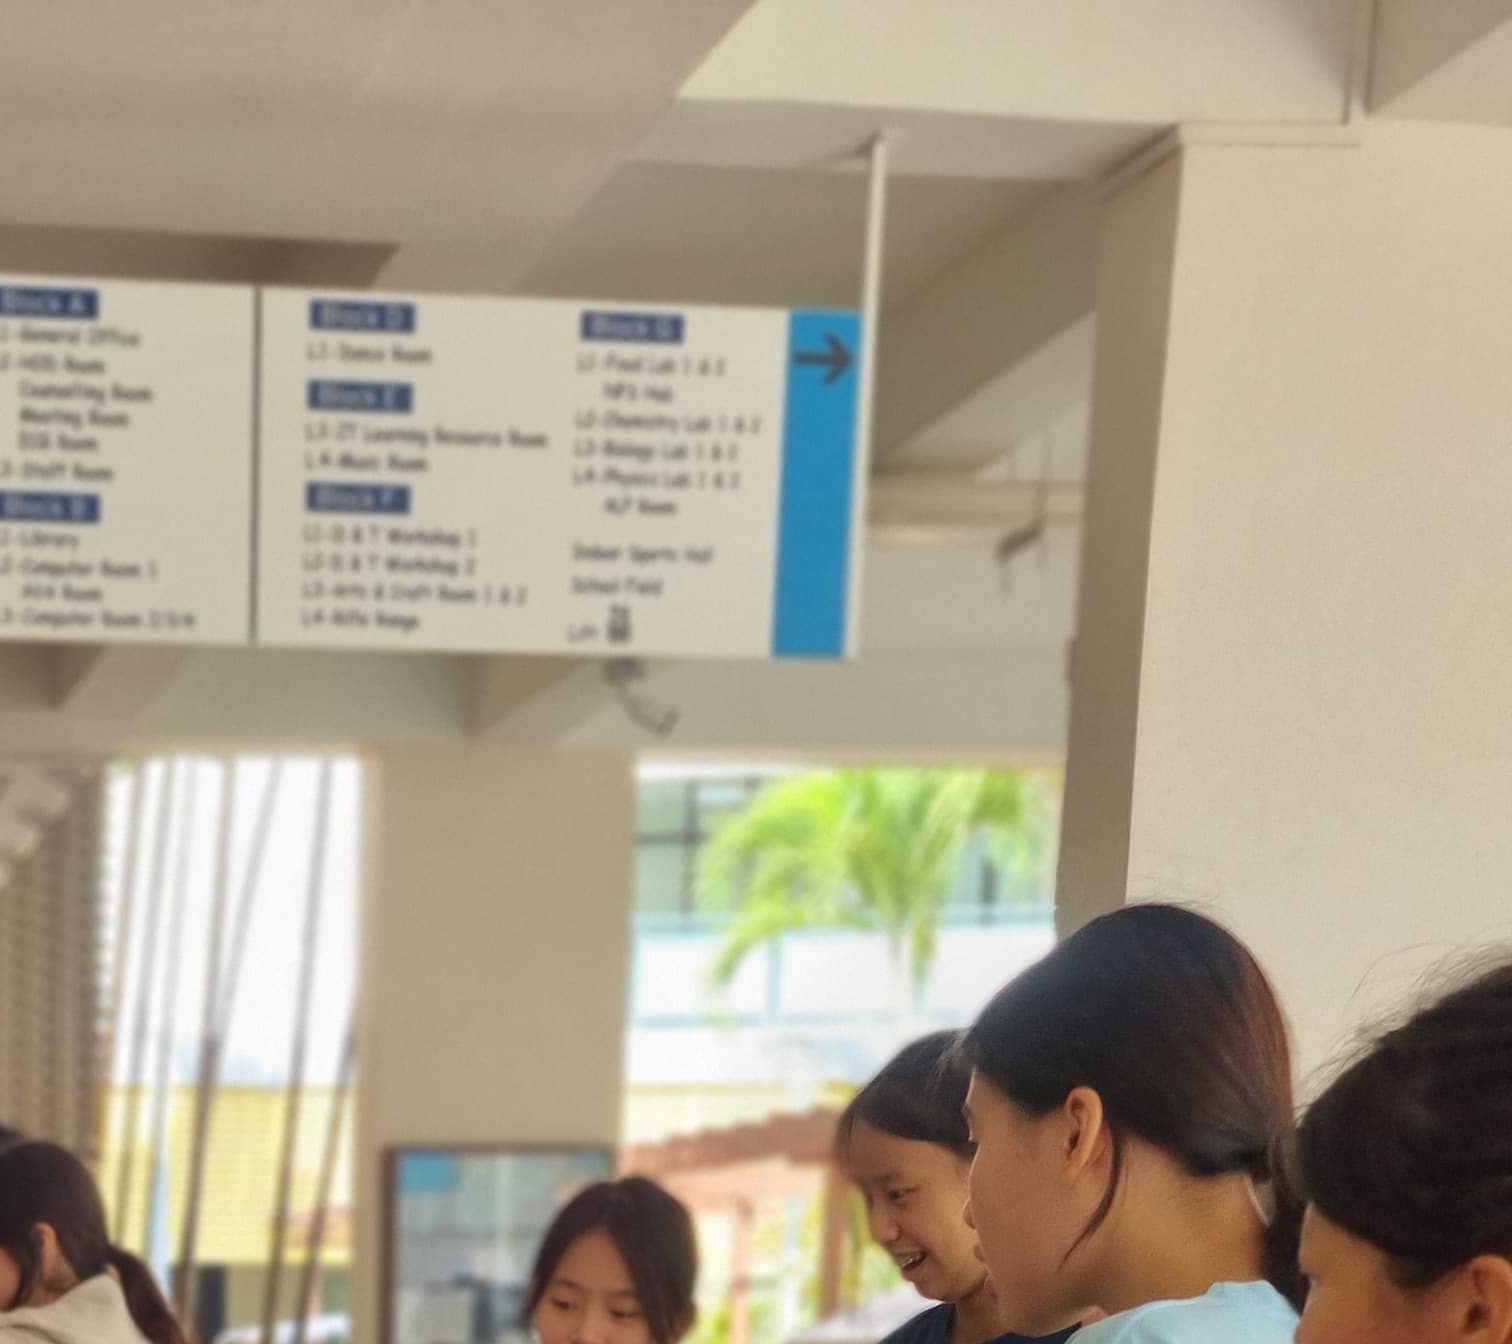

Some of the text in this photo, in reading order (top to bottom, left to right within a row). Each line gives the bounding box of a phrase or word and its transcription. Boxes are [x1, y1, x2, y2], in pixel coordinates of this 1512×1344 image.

[0, 290, 61, 313] Block
[320, 303, 379, 329] Block
[88, 325, 141, 347] Office
[592, 315, 649, 340] Block
[392, 344, 434, 364] Room
[64, 355, 106, 374] Room
[649, 355, 676, 374] Lab
[111, 384, 153, 402] Room
[318, 384, 376, 409] Block
[88, 409, 130, 428] Room
[686, 415, 713, 434] Lab
[57, 433, 100, 452] Room
[364, 424, 428, 450] Learning
[433, 426, 502, 447] Resource
[508, 429, 549, 448] Room
[661, 442, 689, 461] Lab
[72, 461, 115, 481] Room
[388, 452, 428, 472] Room
[663, 471, 691, 490] Lab
[3, 494, 63, 518] Block
[316, 486, 375, 510] Block
[638, 499, 677, 518] Room
[387, 528, 461, 549] Workshop
[683, 545, 715, 565] Hall
[100, 559, 140, 579] Room
[385, 557, 459, 579] Workshop
[62, 583, 103, 602] Room
[438, 585, 477, 603] Room
[572, 575, 619, 595] School
[100, 610, 142, 629] Room
[375, 611, 420, 635] Range
